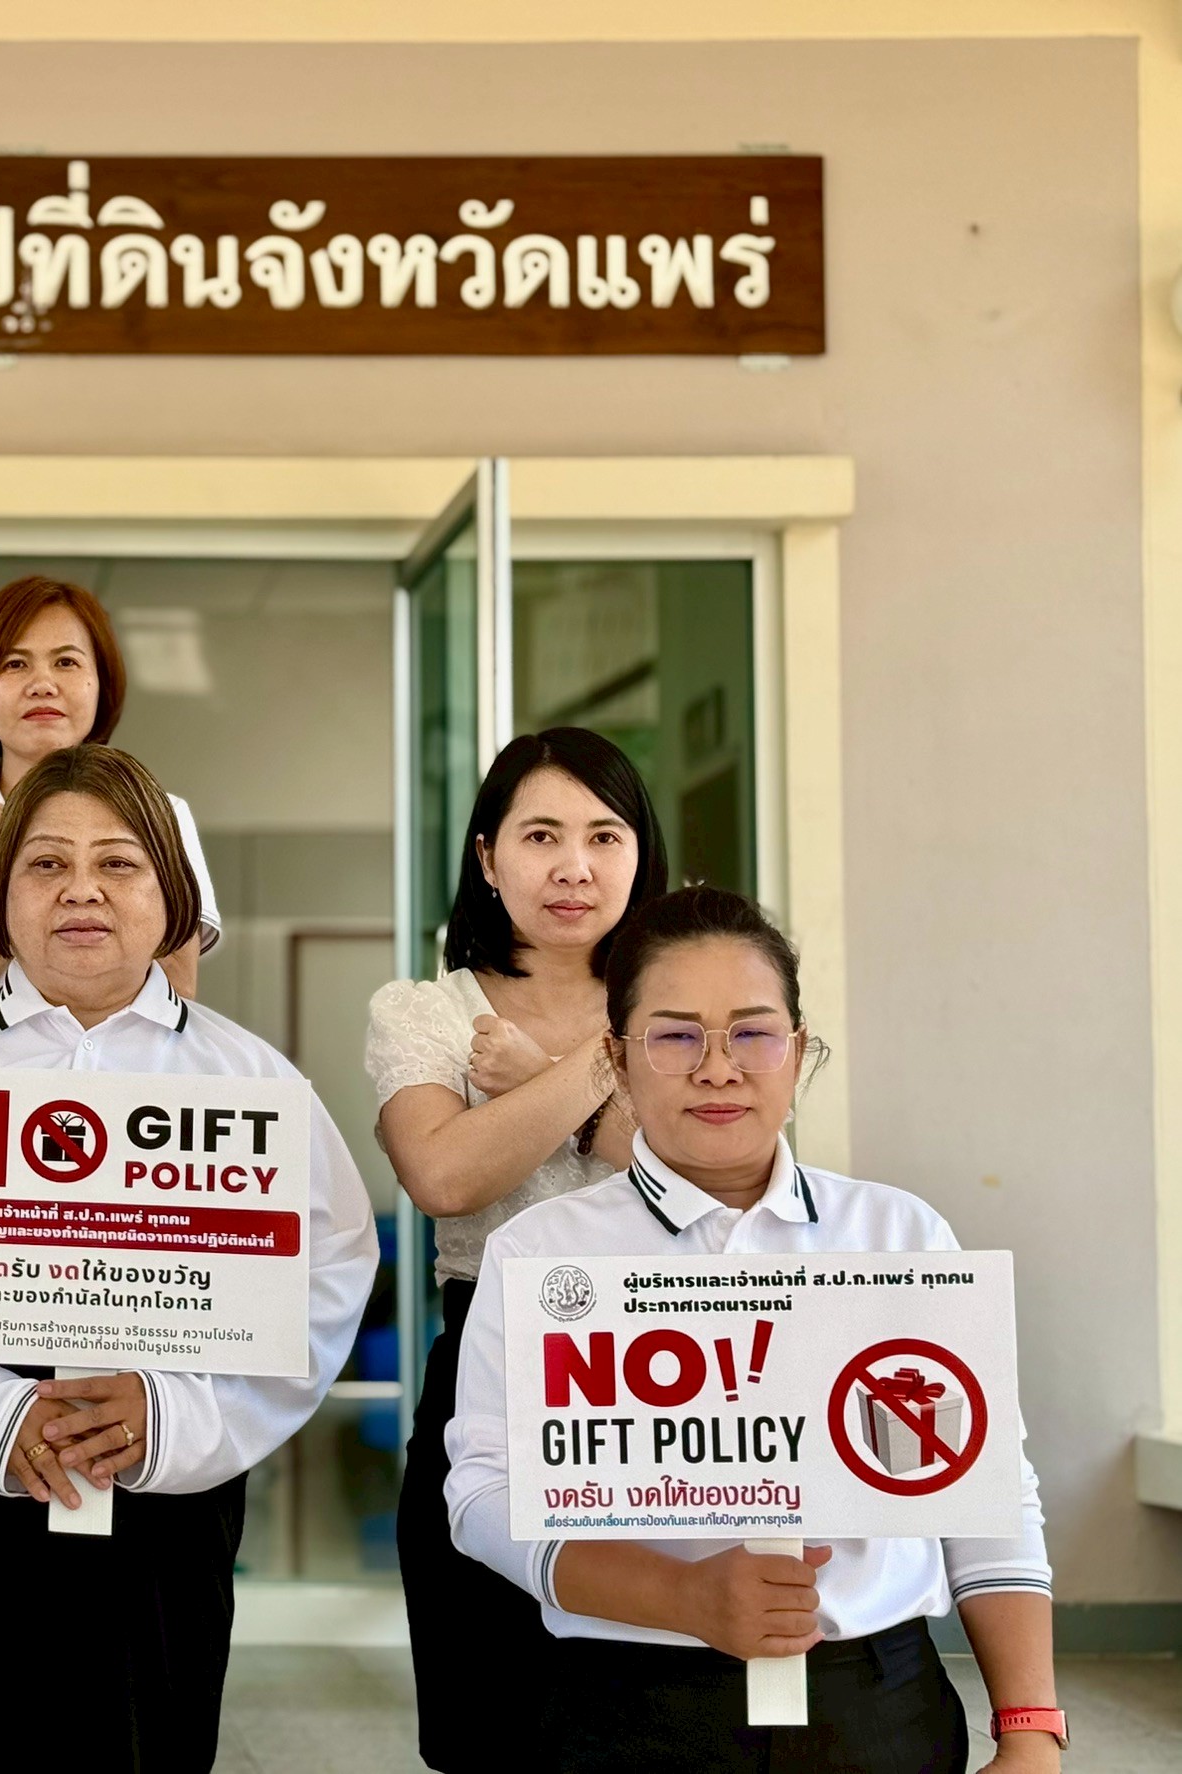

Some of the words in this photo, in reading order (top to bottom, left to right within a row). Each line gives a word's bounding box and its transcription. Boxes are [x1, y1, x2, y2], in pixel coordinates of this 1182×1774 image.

[125, 1104, 279, 1155] GIFT
[124, 1160, 279, 1194] POLICY
[63, 1209, 143, 1224] ส.ป.ก.แพร่
[148, 1214, 190, 1227] ทุกคน
[49, 1259, 211, 1290] งดให้ของขวัญ
[623, 1265, 806, 1293] ผู้บริหารและเจ้าหน้าที่
[812, 1268, 915, 1288] ส.ป.ก.แพร่
[921, 1271, 974, 1288] ทุกคน
[623, 1294, 792, 1313] ประกาศเจตนารมณ์
[2, 1334, 201, 1355] ในการปฏิบัติหน้าที่อย่างเป็นรูปธรรม
[125, 1324, 178, 1338] จริยธรรม
[183, 1327, 253, 1342] ความโปร่งใส
[542, 1418, 635, 1466] GIFT
[653, 1415, 806, 1464] POLICY
[544, 1480, 614, 1509] งดรับ
[626, 1474, 801, 1511] งดให้ของขวัญ
[543, 1511, 803, 1529] เพื่อร่วมขับเคลื่อนการป้องกันและแก้ไขปัญหาการทุจริต
